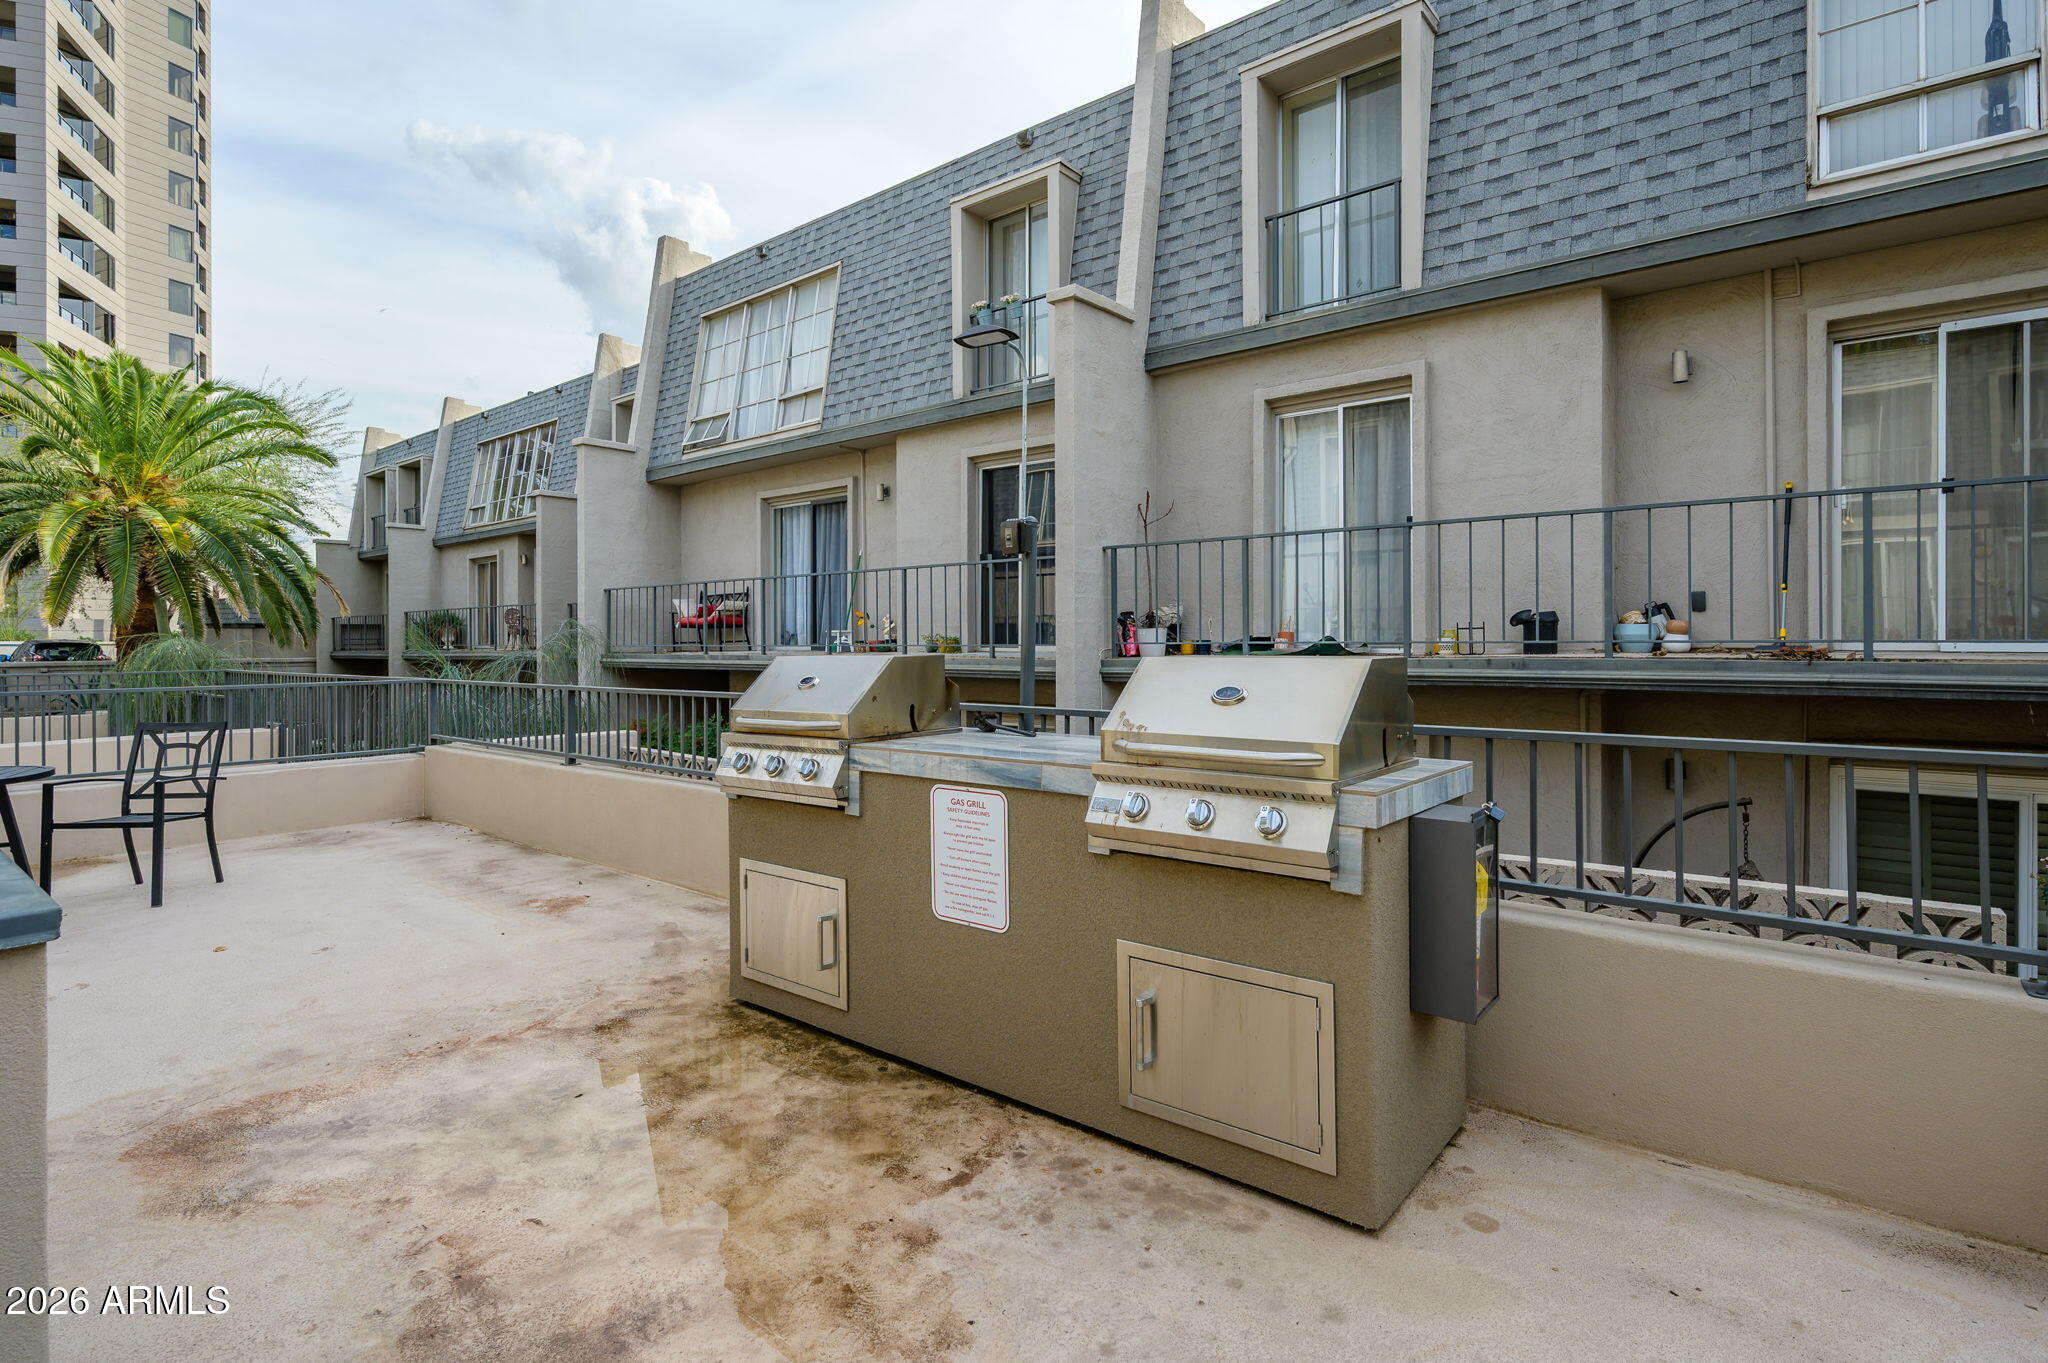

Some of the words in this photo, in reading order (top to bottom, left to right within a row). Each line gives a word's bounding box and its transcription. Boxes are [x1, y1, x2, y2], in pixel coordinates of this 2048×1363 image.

[951, 798, 965, 807] GAS
[967, 800, 987, 809] GRILL
[964, 809, 991, 817] GUIDELINES
